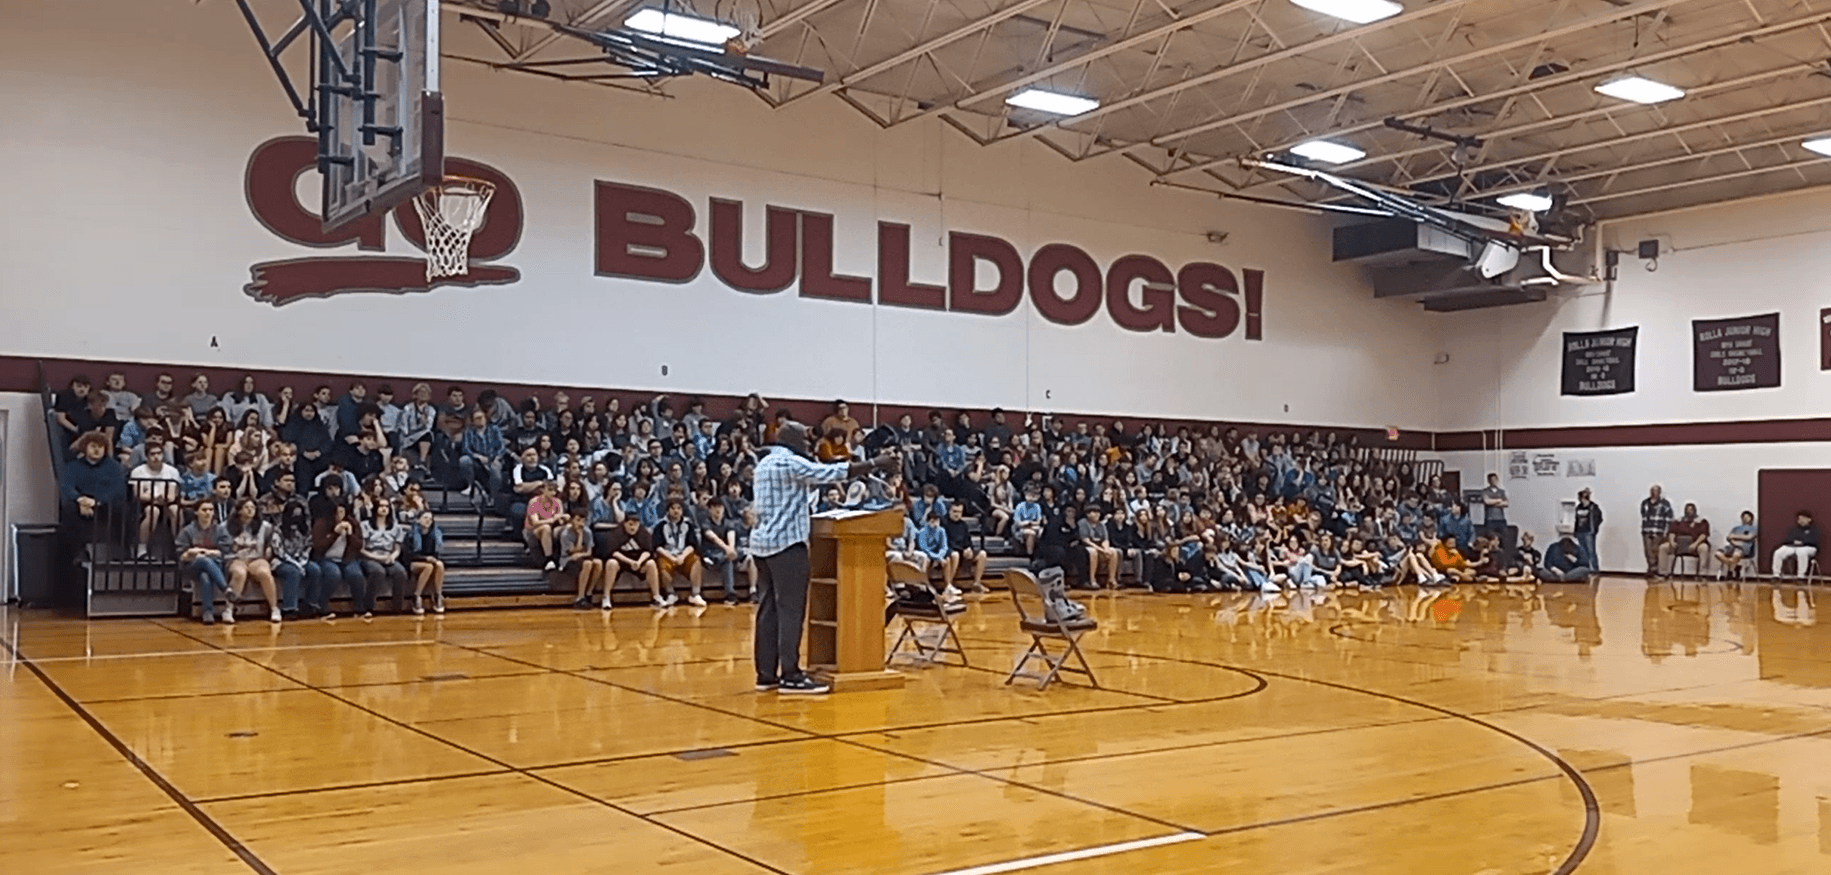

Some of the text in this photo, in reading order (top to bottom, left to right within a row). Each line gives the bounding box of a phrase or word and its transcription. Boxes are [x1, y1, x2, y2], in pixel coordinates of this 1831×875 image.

[244, 135, 1264, 341] GO BULLDOGS!
[210, 336, 218, 347] A
